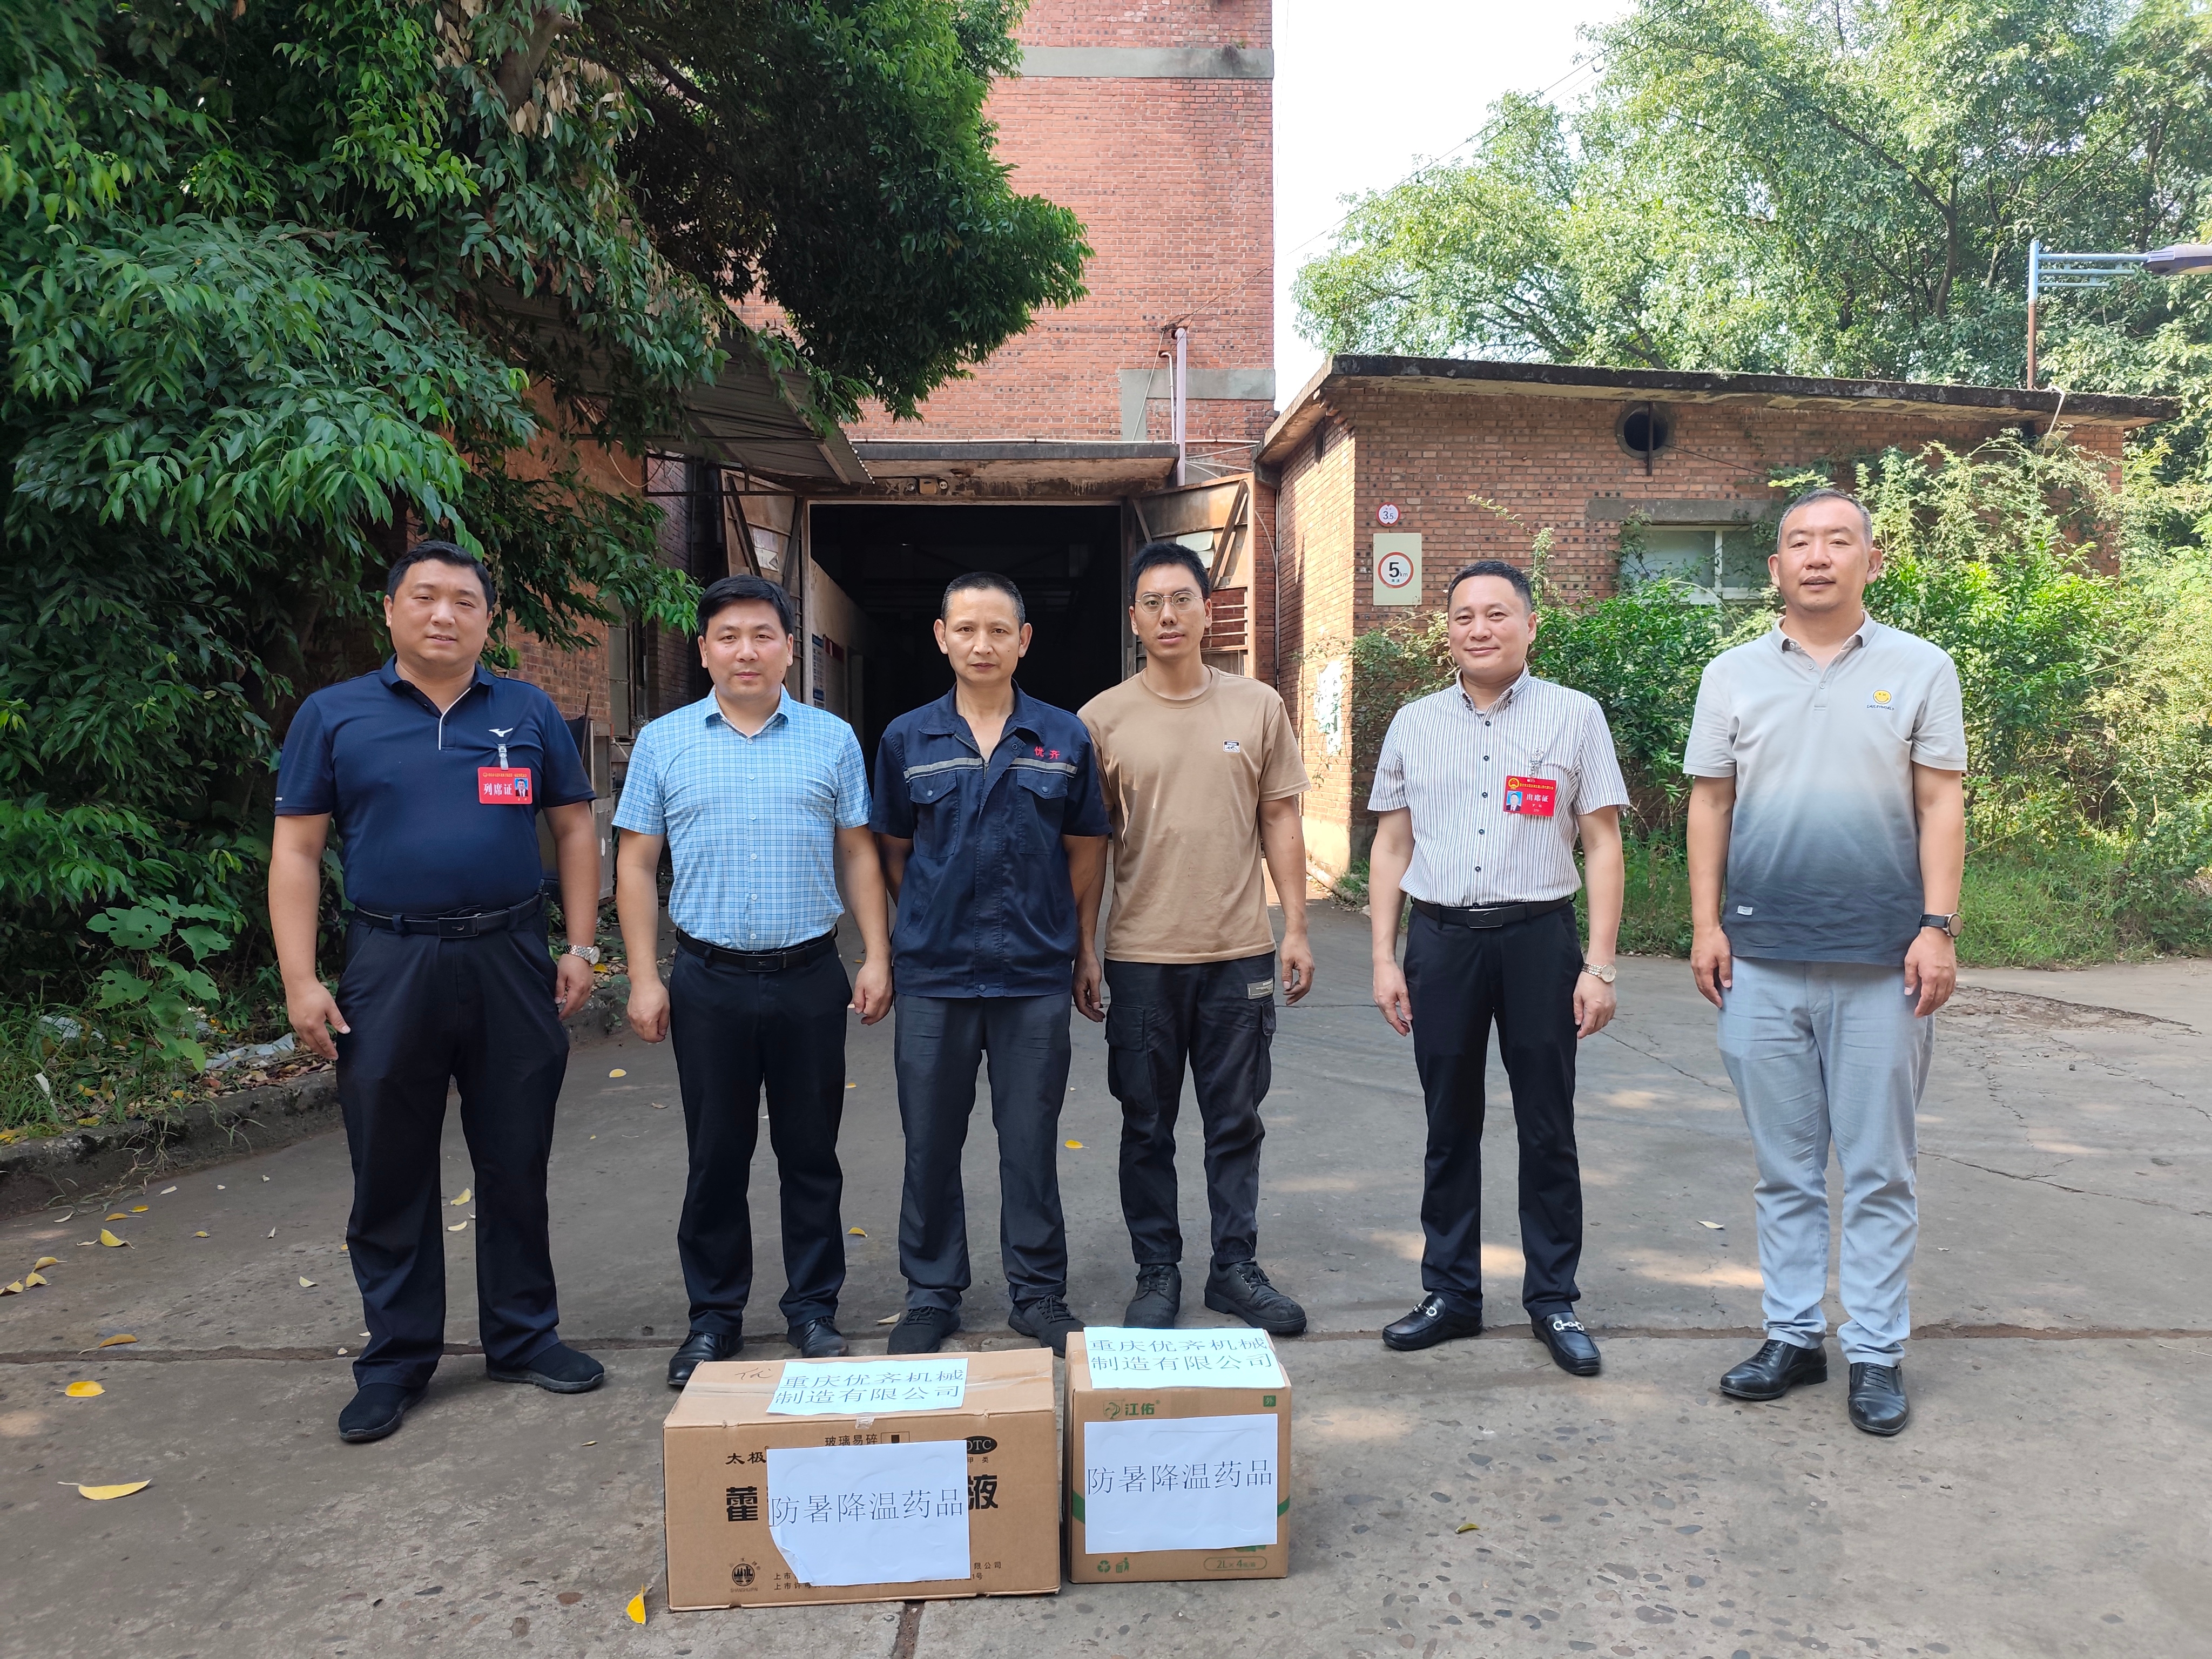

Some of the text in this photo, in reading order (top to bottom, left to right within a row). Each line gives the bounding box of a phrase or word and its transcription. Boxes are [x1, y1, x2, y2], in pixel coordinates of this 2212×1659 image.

[1034, 746, 1060, 759] 优齐
[483, 783, 512, 796] 列席证
[1089, 1338, 1268, 1352] 重庆优齐机械
[1091, 1353, 1272, 1371] 制造有限公司
[780, 1370, 964, 1388] 重庆优齐机械
[775, 1386, 959, 1404] 制造有限公司
[1125, 1402, 1155, 1415] 江佑
[825, 1433, 878, 1447] 玻璃易碎
[725, 1452, 767, 1465] 太极
[1088, 1459, 1272, 1495] 防暑降温药品
[968, 1474, 998, 1510] 液
[771, 1488, 963, 1526] 防暑降温药品
[974, 1561, 1001, 1570] 限公司
